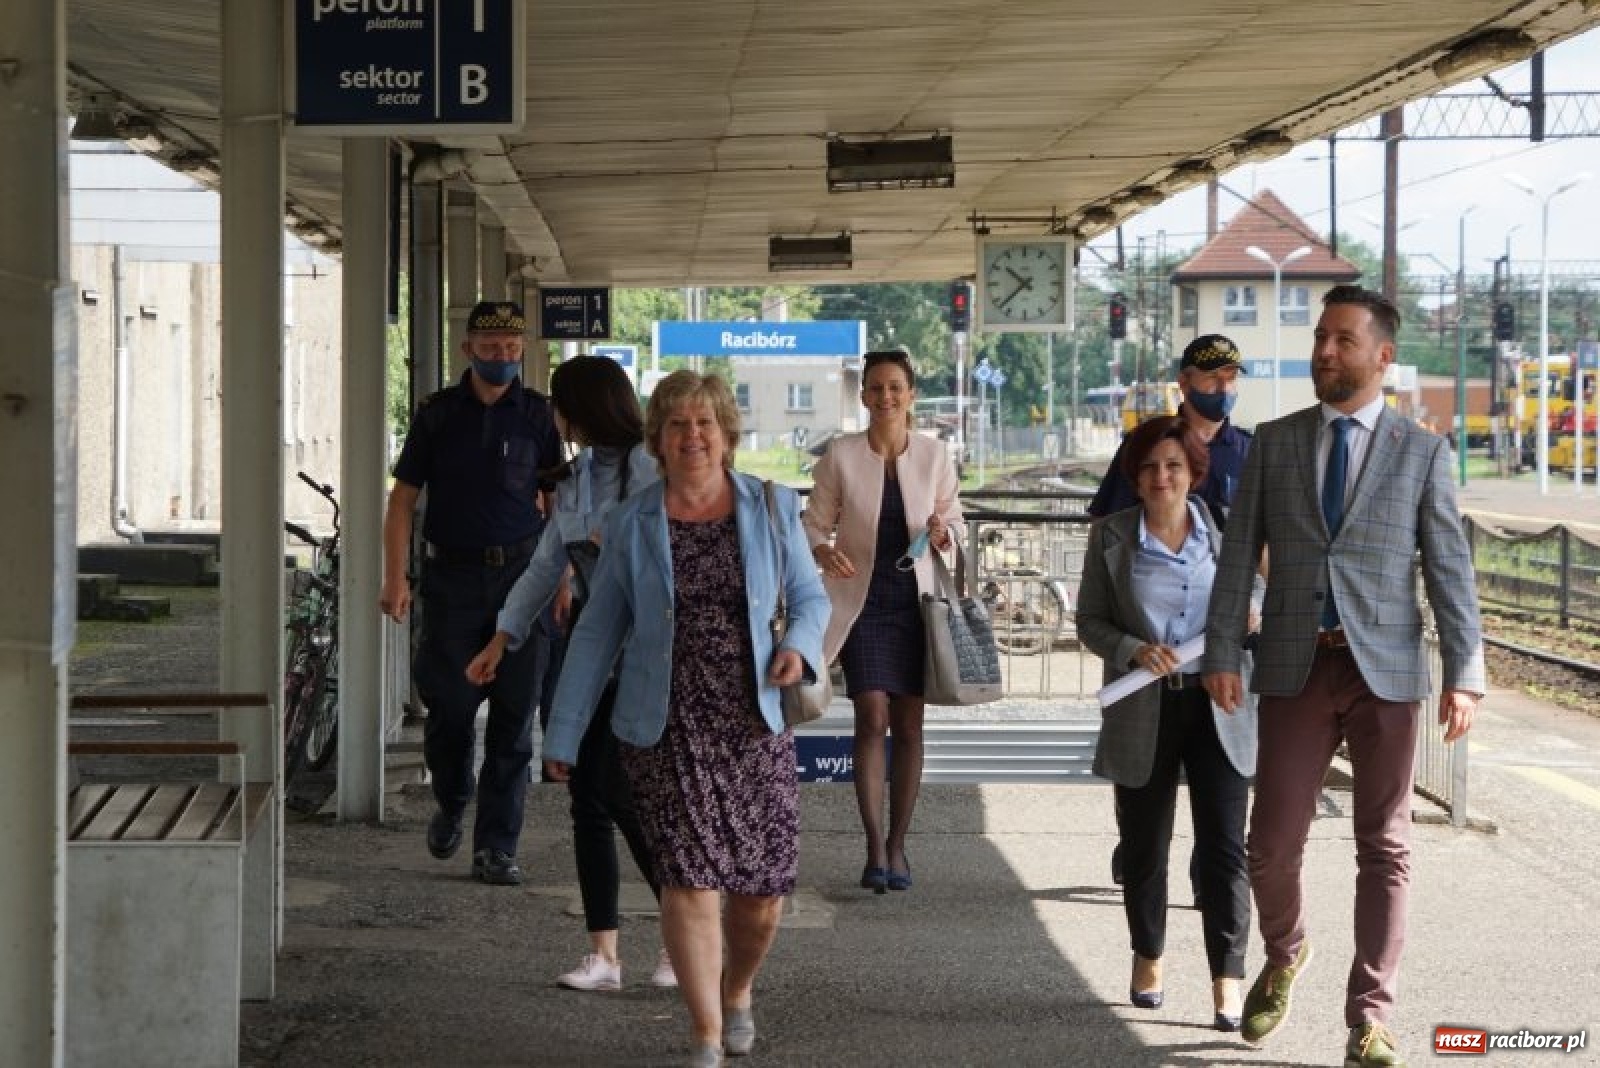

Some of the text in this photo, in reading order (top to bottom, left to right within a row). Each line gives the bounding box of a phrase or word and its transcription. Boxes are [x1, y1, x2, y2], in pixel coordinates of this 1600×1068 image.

[365, 16, 424, 32] platform
[339, 64, 424, 89] sektor
[459, 64, 489, 105] B
[376, 91, 422, 105] sector
[545, 295, 583, 308] peron
[593, 294, 601, 311] 1
[591, 319, 604, 333] A
[721, 331, 797, 349] Racibórz
